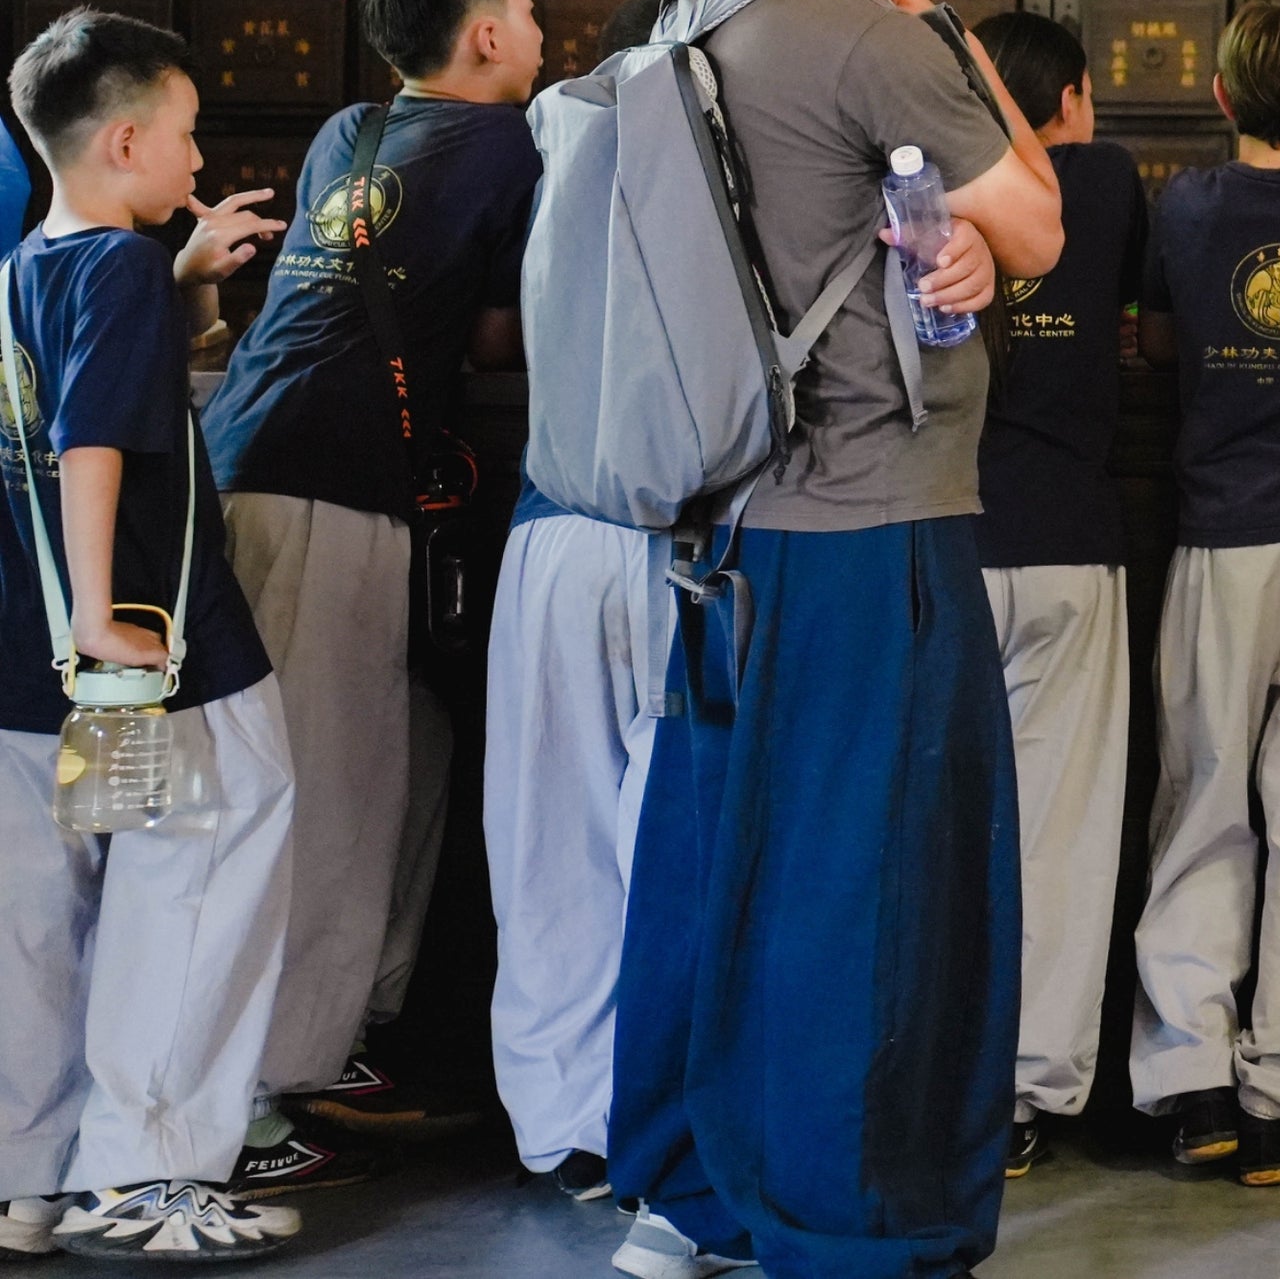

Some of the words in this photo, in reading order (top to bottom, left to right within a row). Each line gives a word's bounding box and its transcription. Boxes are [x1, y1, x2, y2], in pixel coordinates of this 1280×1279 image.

[352, 176, 366, 212] TKK
[1012, 313, 1075, 328] 化中心
[390, 356, 408, 399] TKK
